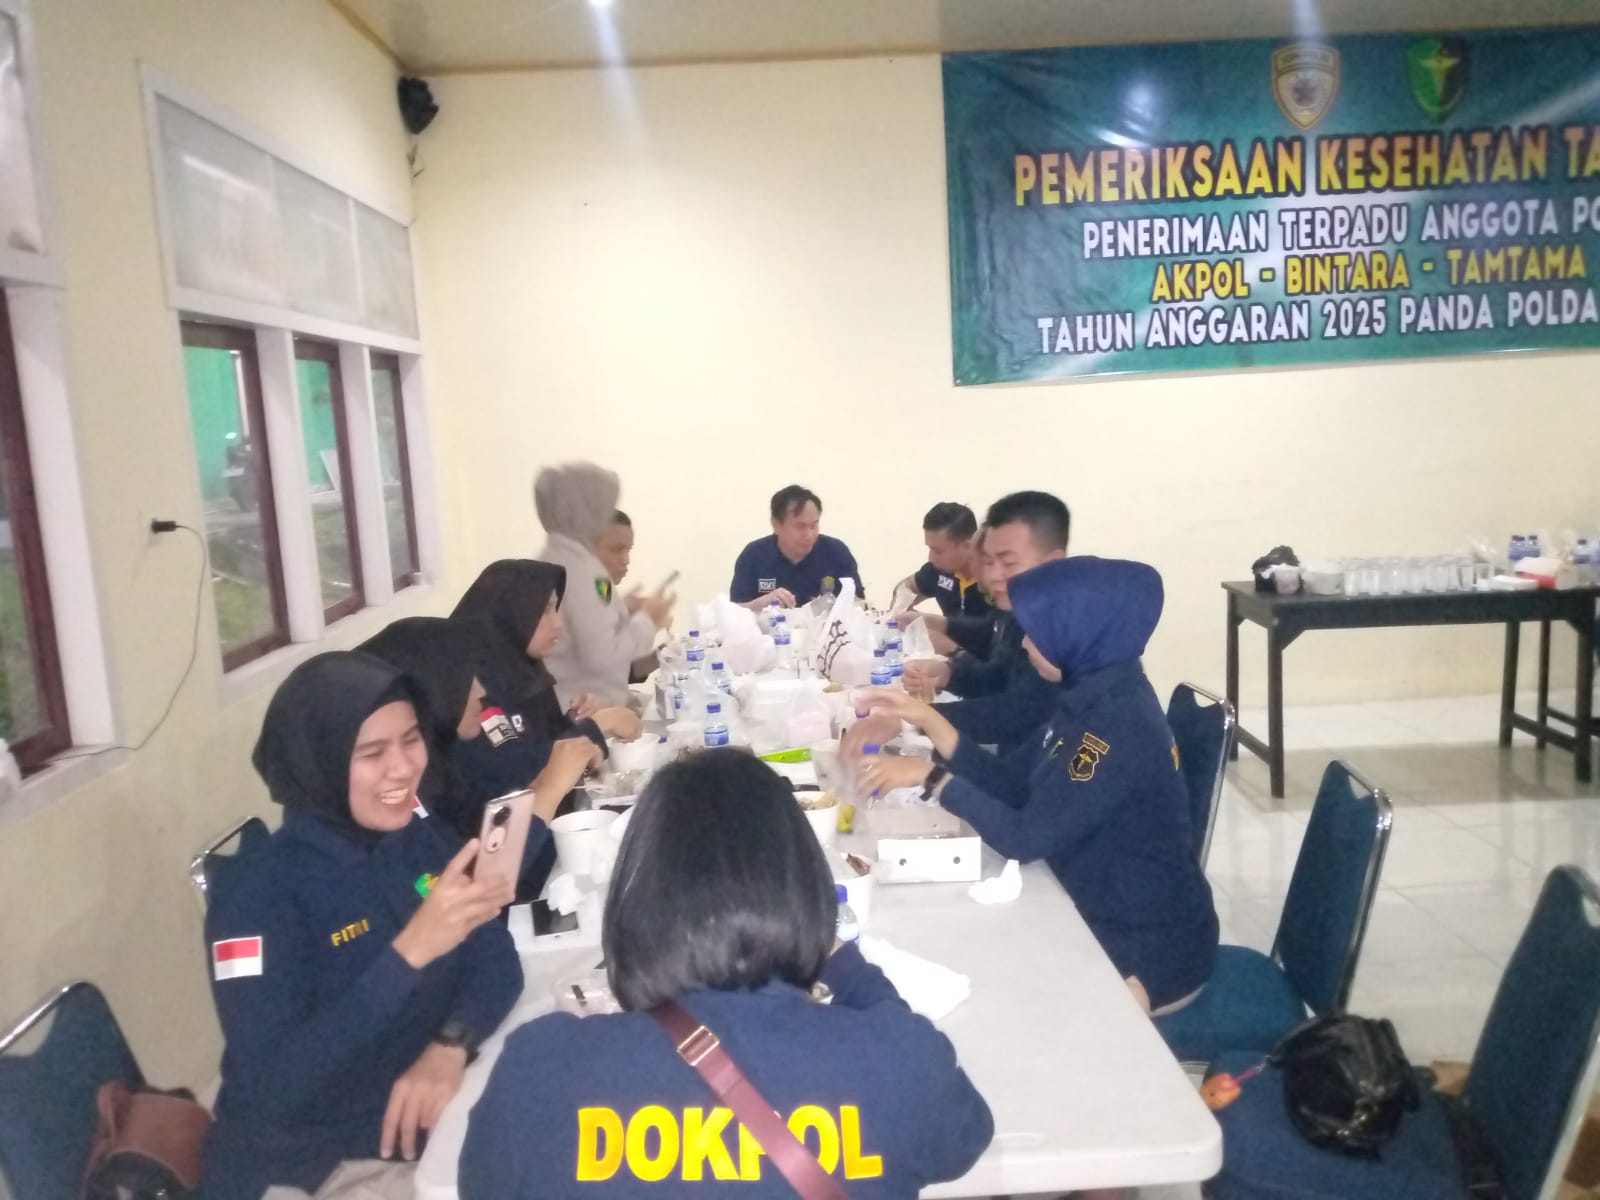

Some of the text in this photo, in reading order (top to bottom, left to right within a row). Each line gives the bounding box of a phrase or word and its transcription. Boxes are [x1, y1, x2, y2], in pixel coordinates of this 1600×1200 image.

[1014, 141, 1303, 206] PEMERIKSAAN
[1319, 127, 1548, 191] KESEHATAN
[1083, 212, 1267, 259] PENERIMAAN
[1280, 204, 1409, 249] TERPADU
[1420, 199, 1559, 241] ANGGOTA
[1151, 260, 1249, 301] AKPOL
[1285, 252, 1410, 294] BINTARA
[1446, 244, 1586, 285] TAMTAMA
[1037, 288, 1599, 353] TAHUN ANGGARAN 2025 PANDA POLDA
